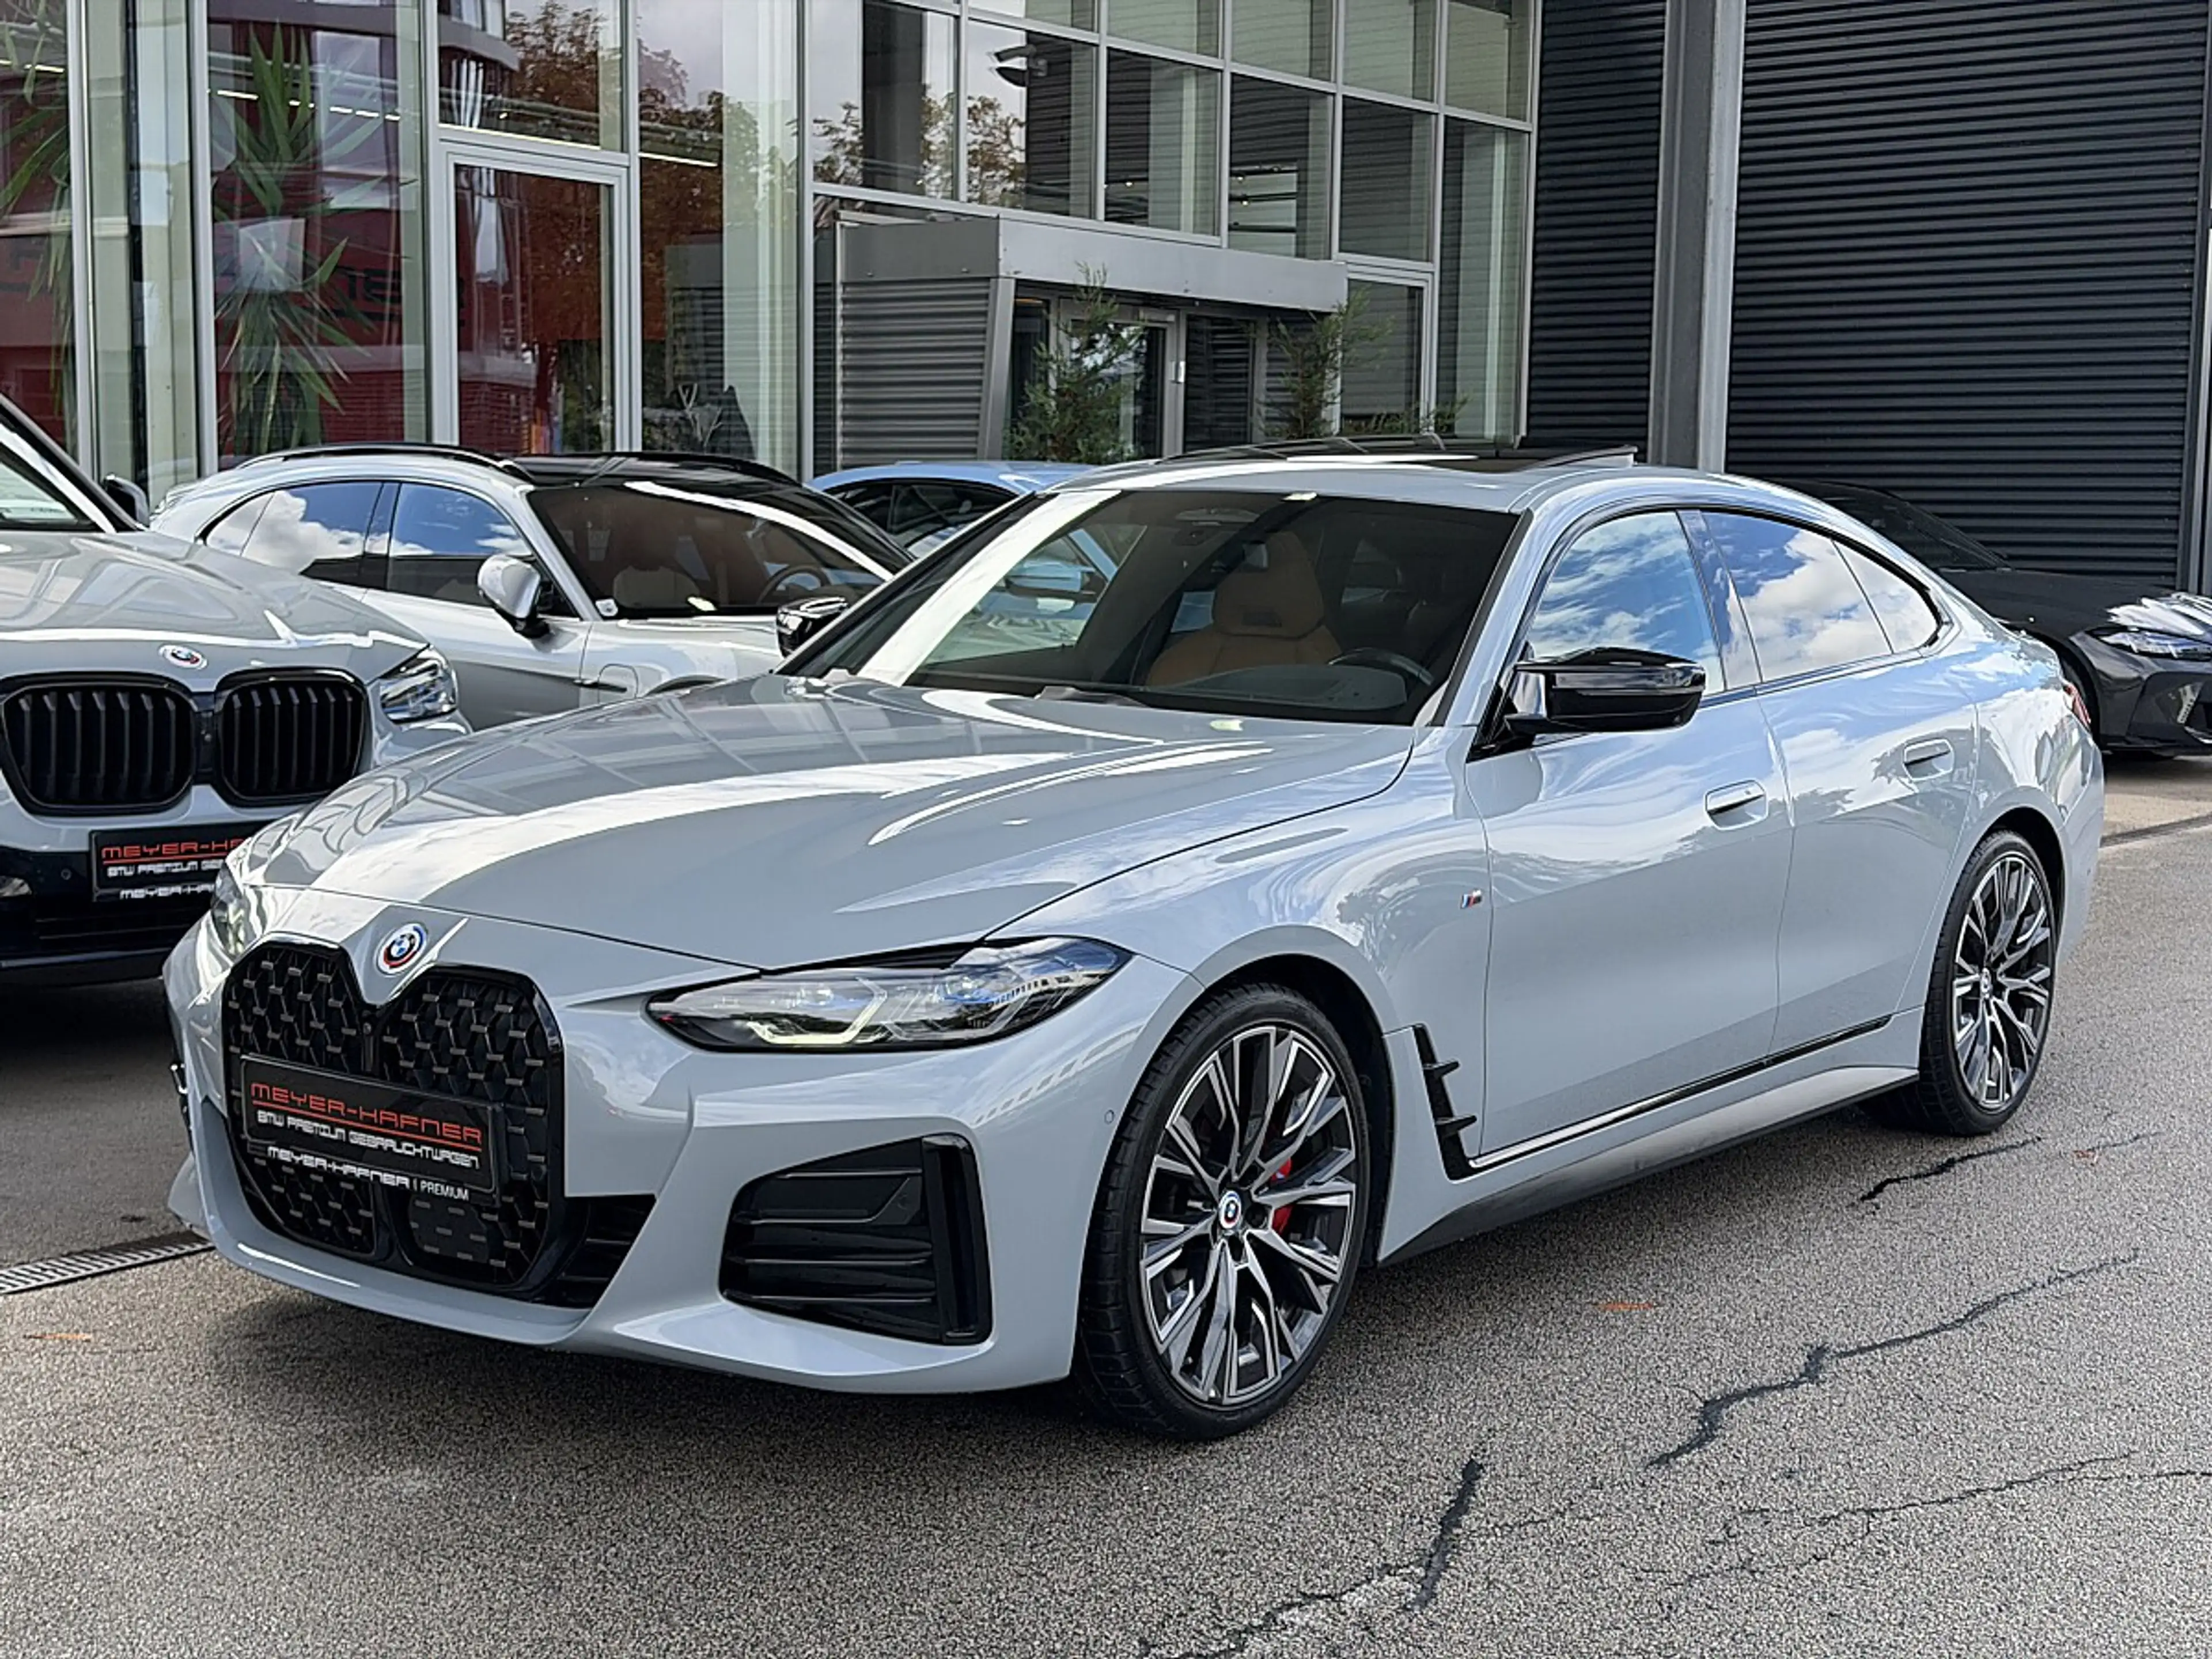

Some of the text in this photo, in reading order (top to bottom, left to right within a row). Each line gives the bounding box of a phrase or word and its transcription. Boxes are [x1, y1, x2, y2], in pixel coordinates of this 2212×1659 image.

[251, 1083, 482, 1144] MEYER-HAFNER
[257, 1109, 479, 1169] BMW PREMIUM GEBRAUCHTWAGEN
[267, 1146, 410, 1189] MEYER-HAFNER
[420, 1180, 469, 1201] PREMIUM
